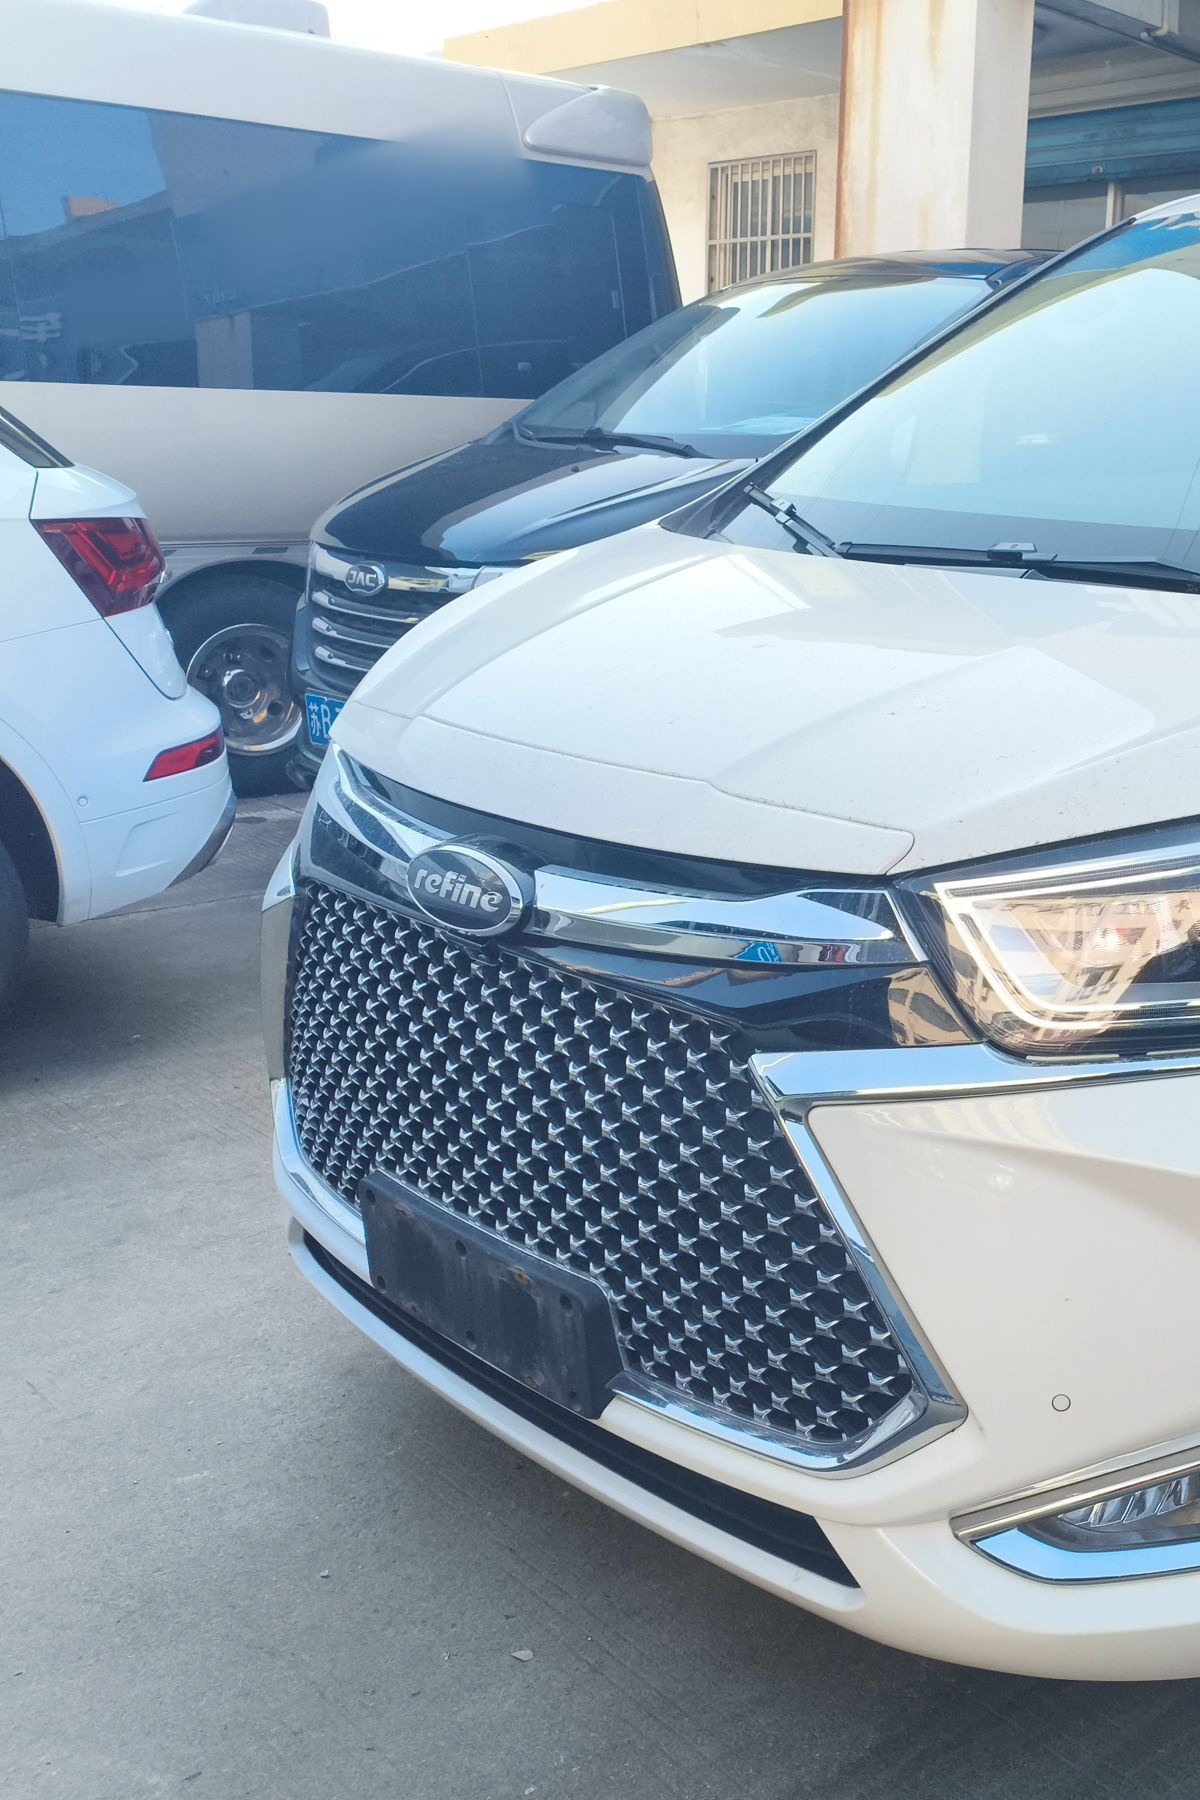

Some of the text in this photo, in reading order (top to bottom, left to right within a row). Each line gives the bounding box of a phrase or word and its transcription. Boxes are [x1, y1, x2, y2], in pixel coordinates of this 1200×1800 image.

[347, 570, 377, 587] JAC
[308, 702, 342, 739] 苏B
[414, 868, 504, 913] refine
